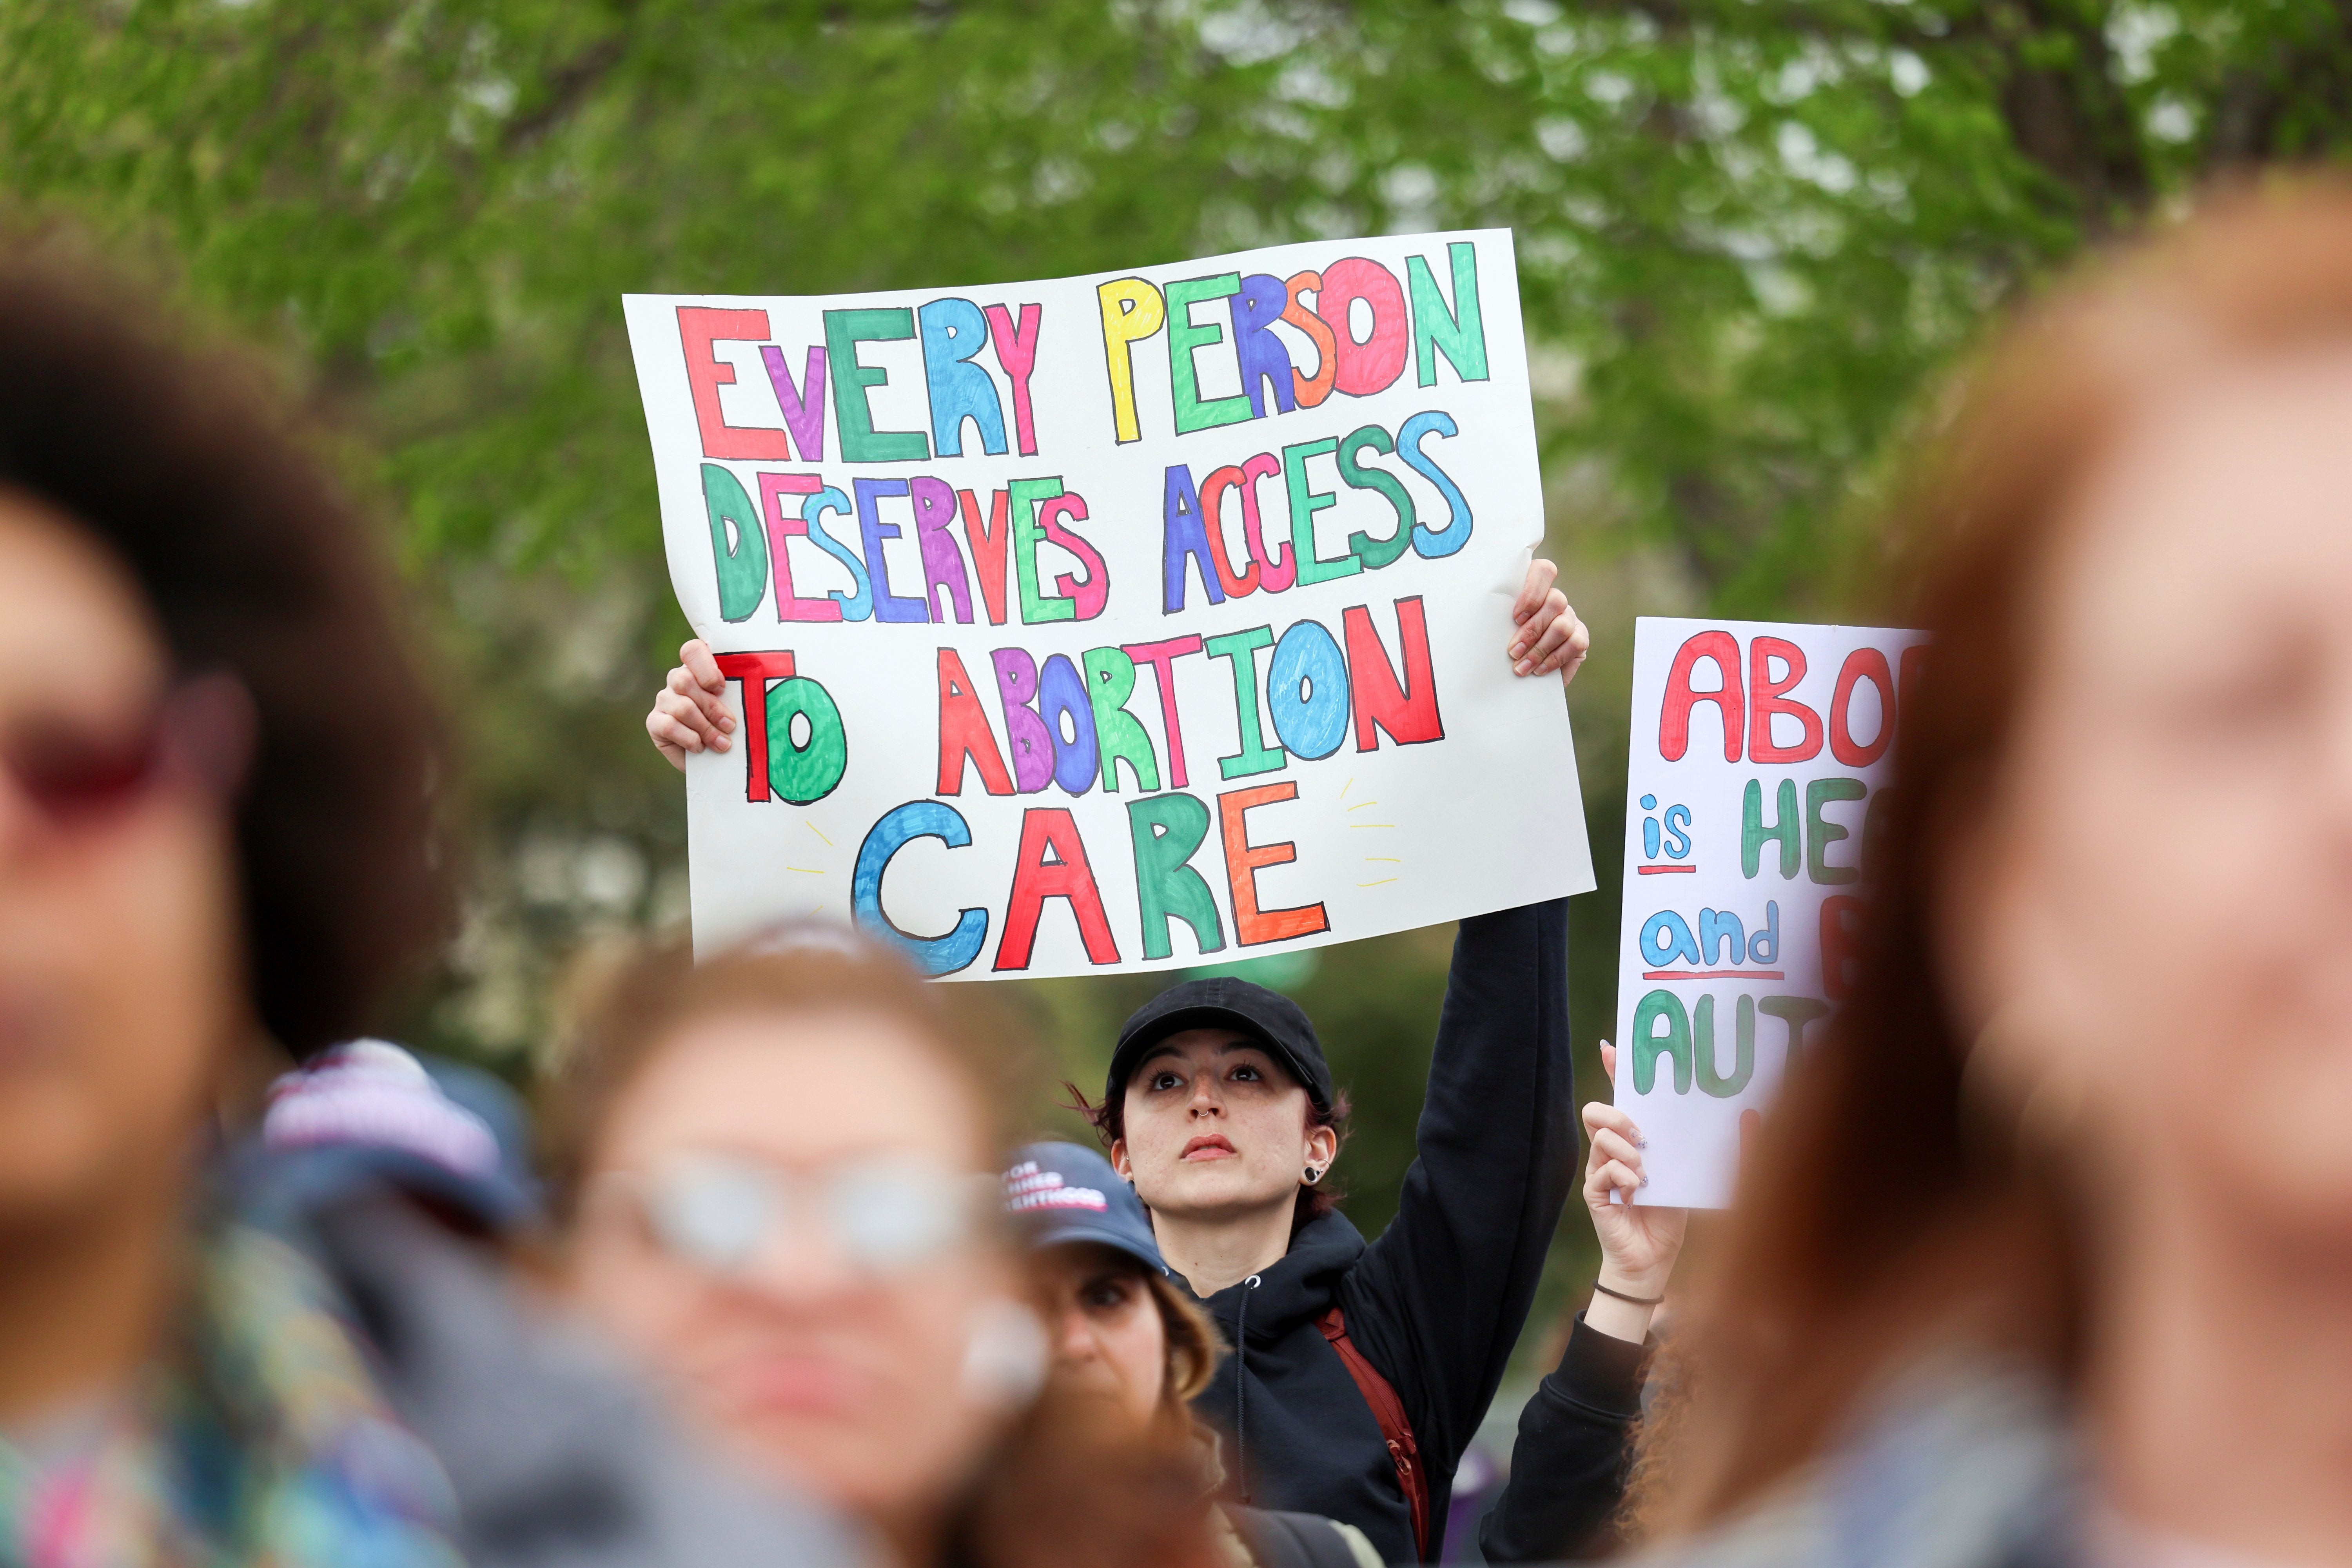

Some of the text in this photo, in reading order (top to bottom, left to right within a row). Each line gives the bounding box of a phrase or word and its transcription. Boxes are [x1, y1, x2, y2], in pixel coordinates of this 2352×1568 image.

[675, 241, 1490, 463] EVERY PERSON
[701, 410, 1473, 626] DESERVES ACCESS
[712, 595, 1445, 806] TO ABORTION
[1659, 630, 1921, 768] ABO
[851, 780, 1331, 980] CARE
[1639, 777, 1887, 886] is HE
[1639, 899, 1779, 967] and
[1632, 989, 1831, 1098] AUT
